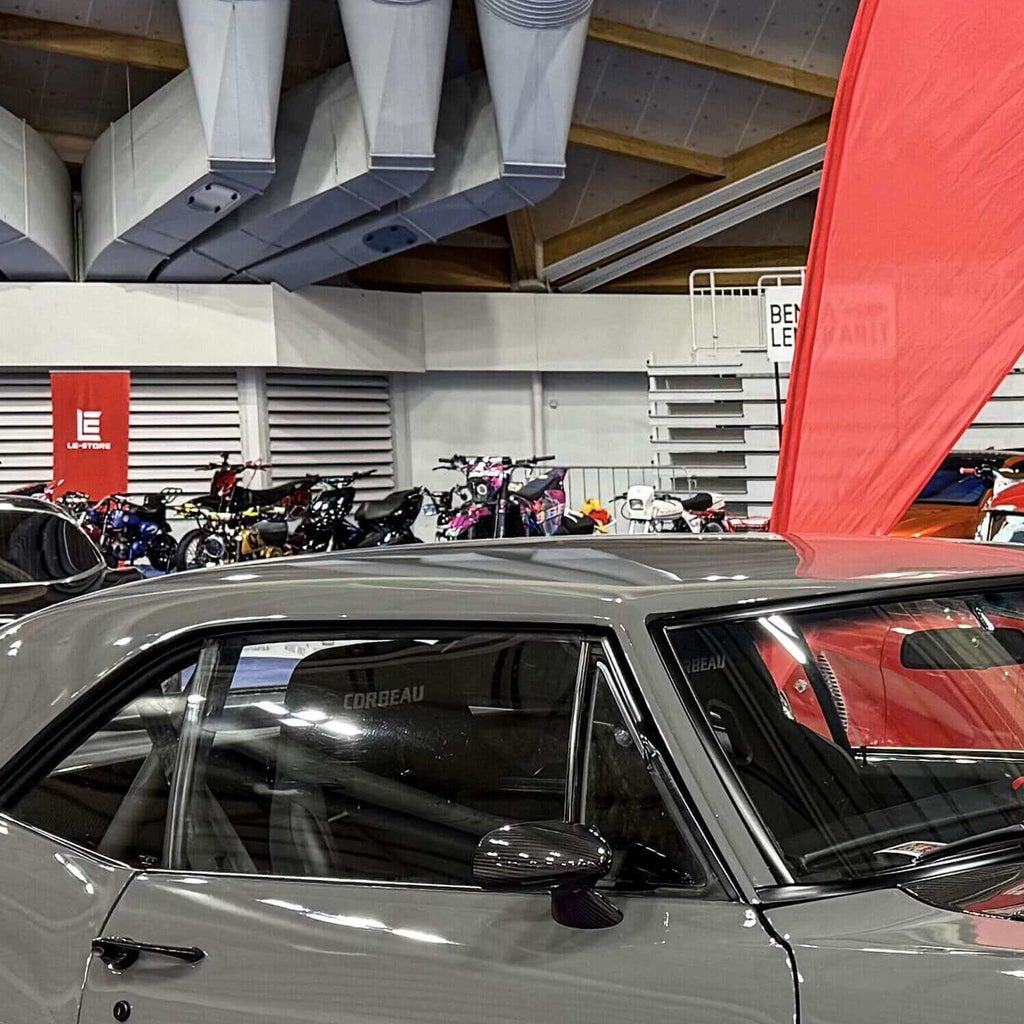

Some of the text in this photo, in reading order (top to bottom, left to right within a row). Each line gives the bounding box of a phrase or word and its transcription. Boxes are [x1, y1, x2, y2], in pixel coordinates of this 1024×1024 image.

[771, 327, 798, 347] LE
[67, 442, 111, 450] LE-STORE
[343, 685, 425, 709] CORBEAU
